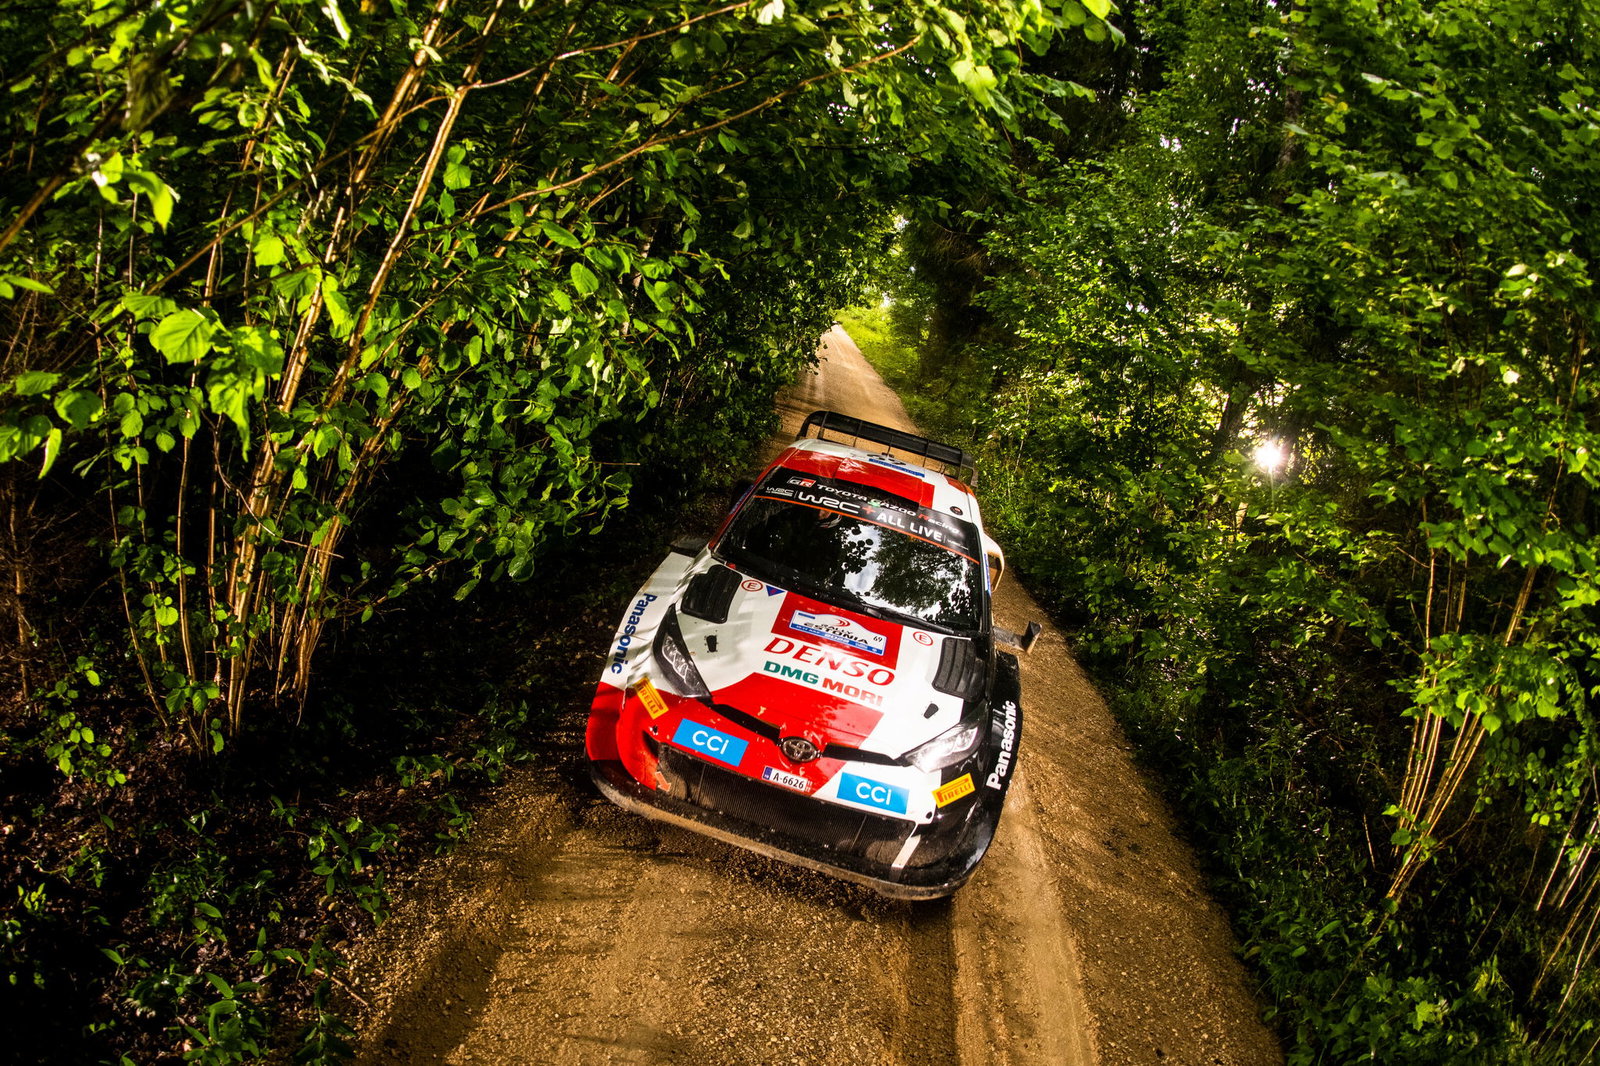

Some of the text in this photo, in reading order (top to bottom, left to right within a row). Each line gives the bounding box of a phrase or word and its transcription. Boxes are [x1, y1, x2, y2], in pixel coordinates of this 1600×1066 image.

[788, 478, 816, 488] GR
[817, 484, 867, 501] TOYOTA
[869, 499, 917, 517] GAZOO
[876, 512, 906, 529] ALL
[909, 522, 943, 542] LIVE
[611, 593, 658, 675] Panasonic
[803, 622, 869, 645] ESTONIA
[763, 636, 895, 686] DENSO
[763, 660, 884, 707] DMG MORI
[985, 700, 1017, 791] Panasonic
[772, 771, 805, 790] A-6626
[935, 777, 971, 803] PIRELLI
